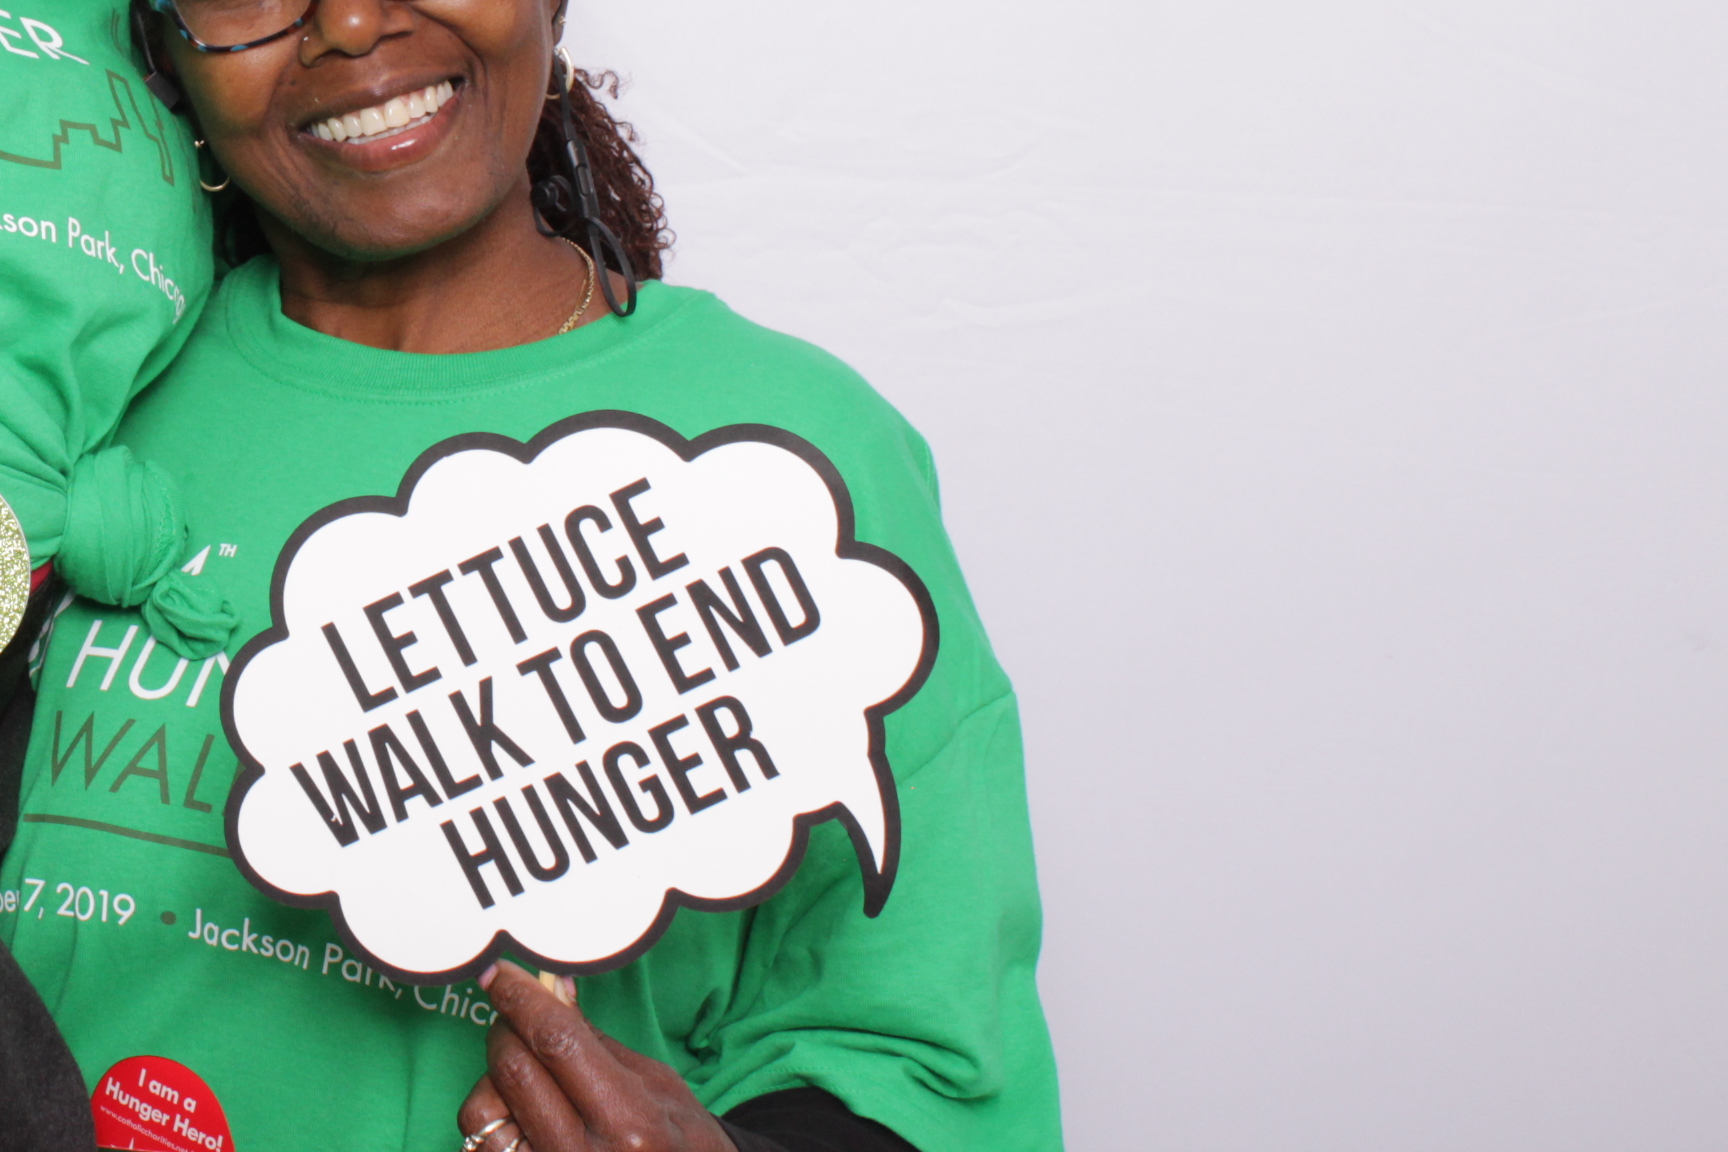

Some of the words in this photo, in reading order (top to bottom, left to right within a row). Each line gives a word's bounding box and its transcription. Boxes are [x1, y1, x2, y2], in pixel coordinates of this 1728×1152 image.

[68, 216, 125, 275] Park,
[321, 477, 691, 713] LETTUCE
[289, 675, 536, 848] WALK
[515, 629, 644, 745] TO
[635, 546, 821, 696] END
[51, 709, 246, 814] WAL
[440, 695, 782, 911] HUNGER
[23, 878, 46, 919] 7,
[56, 882, 136, 926] 2019
[188, 908, 310, 970] Jackson
[105, 1077, 170, 1126] Hunger
[173, 1114, 224, 1152] Hero!
[138, 1068, 147, 1087] I
[148, 1079, 179, 1105] am
[183, 1097, 197, 1113] a
